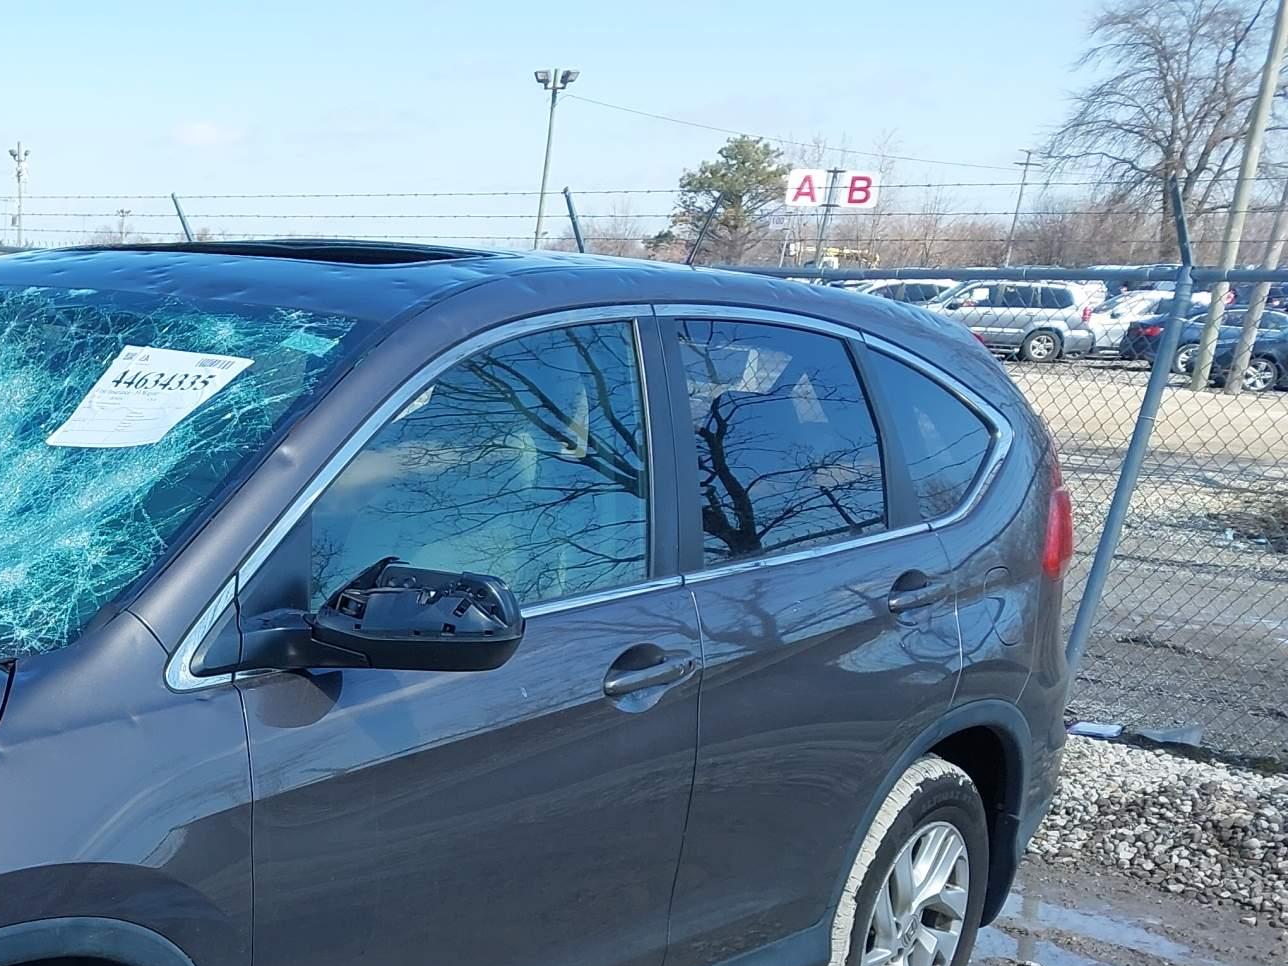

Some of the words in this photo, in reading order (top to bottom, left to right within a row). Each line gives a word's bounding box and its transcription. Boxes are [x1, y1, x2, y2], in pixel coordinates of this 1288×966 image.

[792, 174, 817, 203] A
[847, 175, 873, 204] B
[112, 369, 217, 391] 44634335
